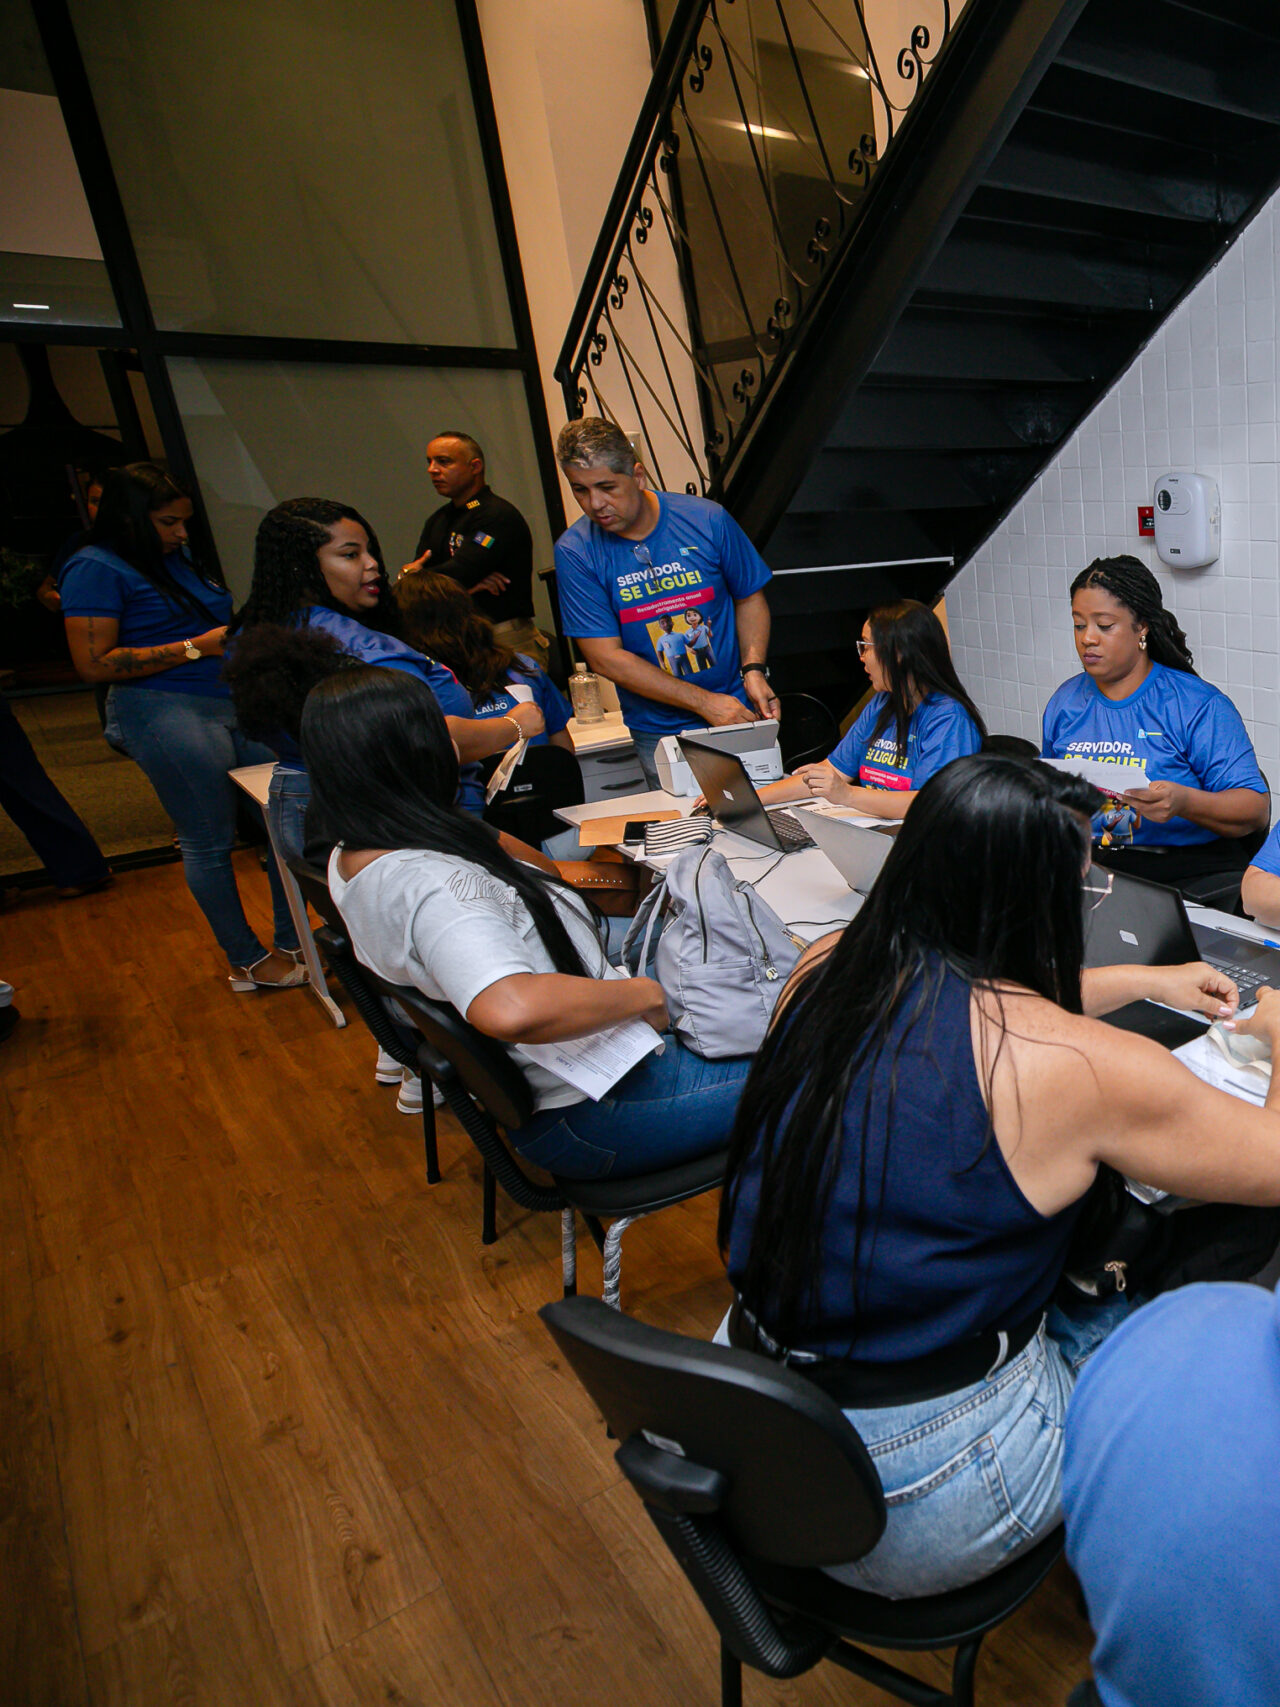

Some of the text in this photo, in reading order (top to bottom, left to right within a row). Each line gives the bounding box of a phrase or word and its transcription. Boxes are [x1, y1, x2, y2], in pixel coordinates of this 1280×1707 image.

[617, 561, 687, 587] SERVIDOR,
[619, 585, 643, 602] SE
[475, 702, 508, 715] LAURO
[1066, 741, 1135, 756] SERVIDOR,
